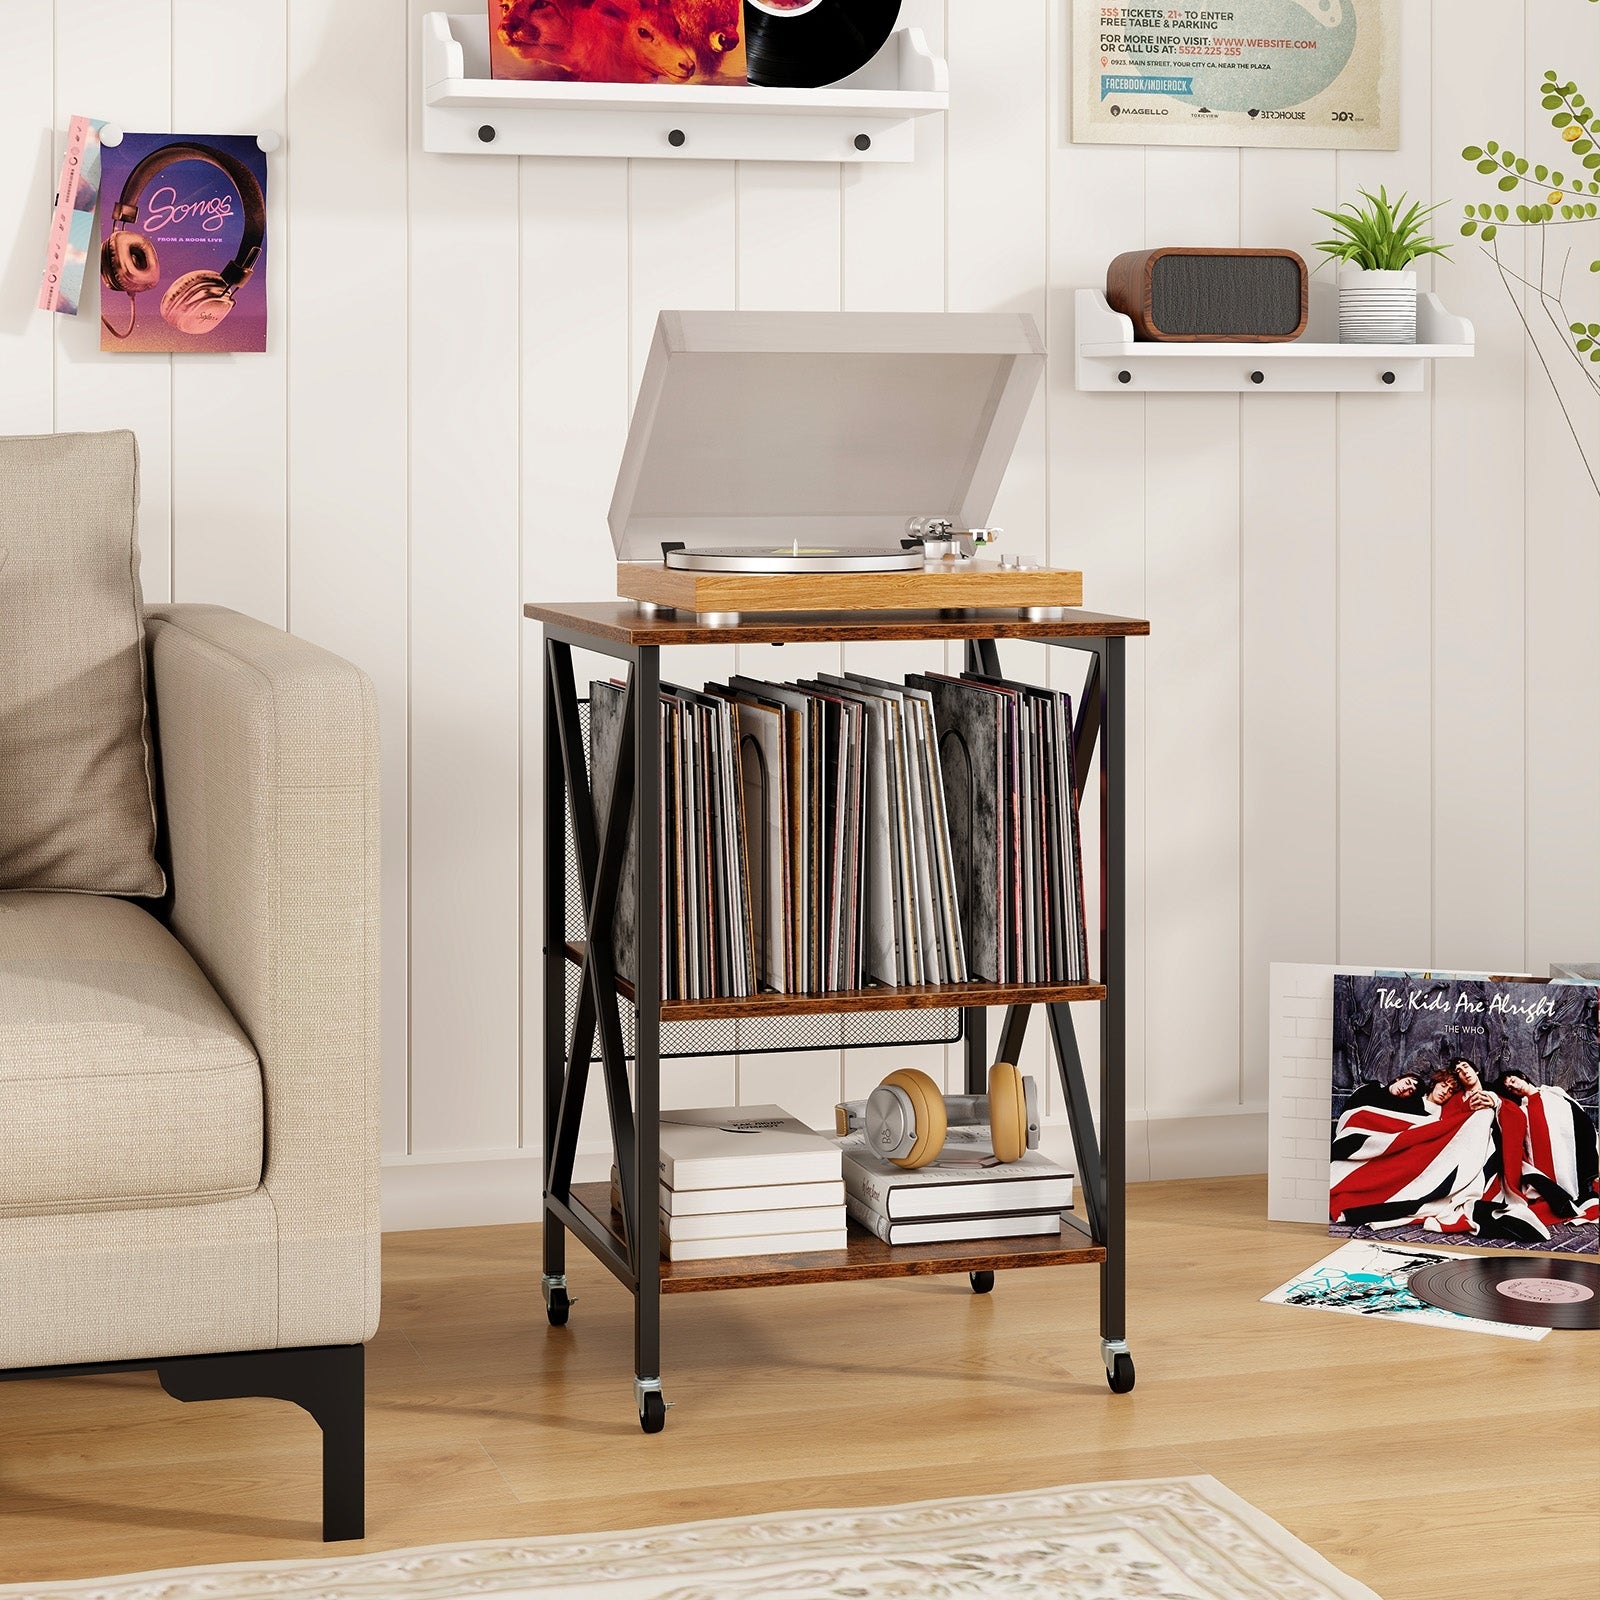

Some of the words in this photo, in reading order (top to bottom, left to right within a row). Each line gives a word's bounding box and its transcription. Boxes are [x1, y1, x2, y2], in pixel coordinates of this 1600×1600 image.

[1101, 8, 1119, 18] 35$
[1121, 9, 1166, 19] TICKETS,
[1168, 10, 1183, 19] 21+
[1185, 11, 1198, 20] TO
[1201, 12, 1234, 21] ENTER
[1100, 18, 1127, 27] FREE
[1129, 19, 1160, 28] TABLE
[1163, 20, 1170, 28] &
[1172, 20, 1218, 30] PARKING
[1100, 34, 1121, 43] FOR
[1123, 35, 1154, 44] MORE
[1156, 36, 1180, 45] INFO
[1183, 37, 1211, 46] VISIT:
[1213, 37, 1317, 49] WWW.WEBSITE.COM
[1100, 43, 1117, 52] OR
[1118, 44, 1143, 53] CALL
[1145, 45, 1159, 54] US
[1161, 45, 1177, 54] AT:
[1178, 46, 1202, 55] 5522
[1204, 47, 1221, 56] 225
[1224, 47, 1241, 56] 255
[1105, 78, 1188, 91] FACEBOOK/INDIEROCK
[1121, 108, 1169, 116] MAGELLO
[1261, 111, 1306, 120] BIRDHOUSE
[143, 187, 234, 232] Songs
[1376, 988, 1403, 1010] The
[1408, 991, 1451, 1013] Kids
[1454, 991, 1485, 1014] Are
[1488, 992, 1556, 1023] Alright
[1444, 1024, 1460, 1034] THE
[1462, 1025, 1485, 1035] WHO
